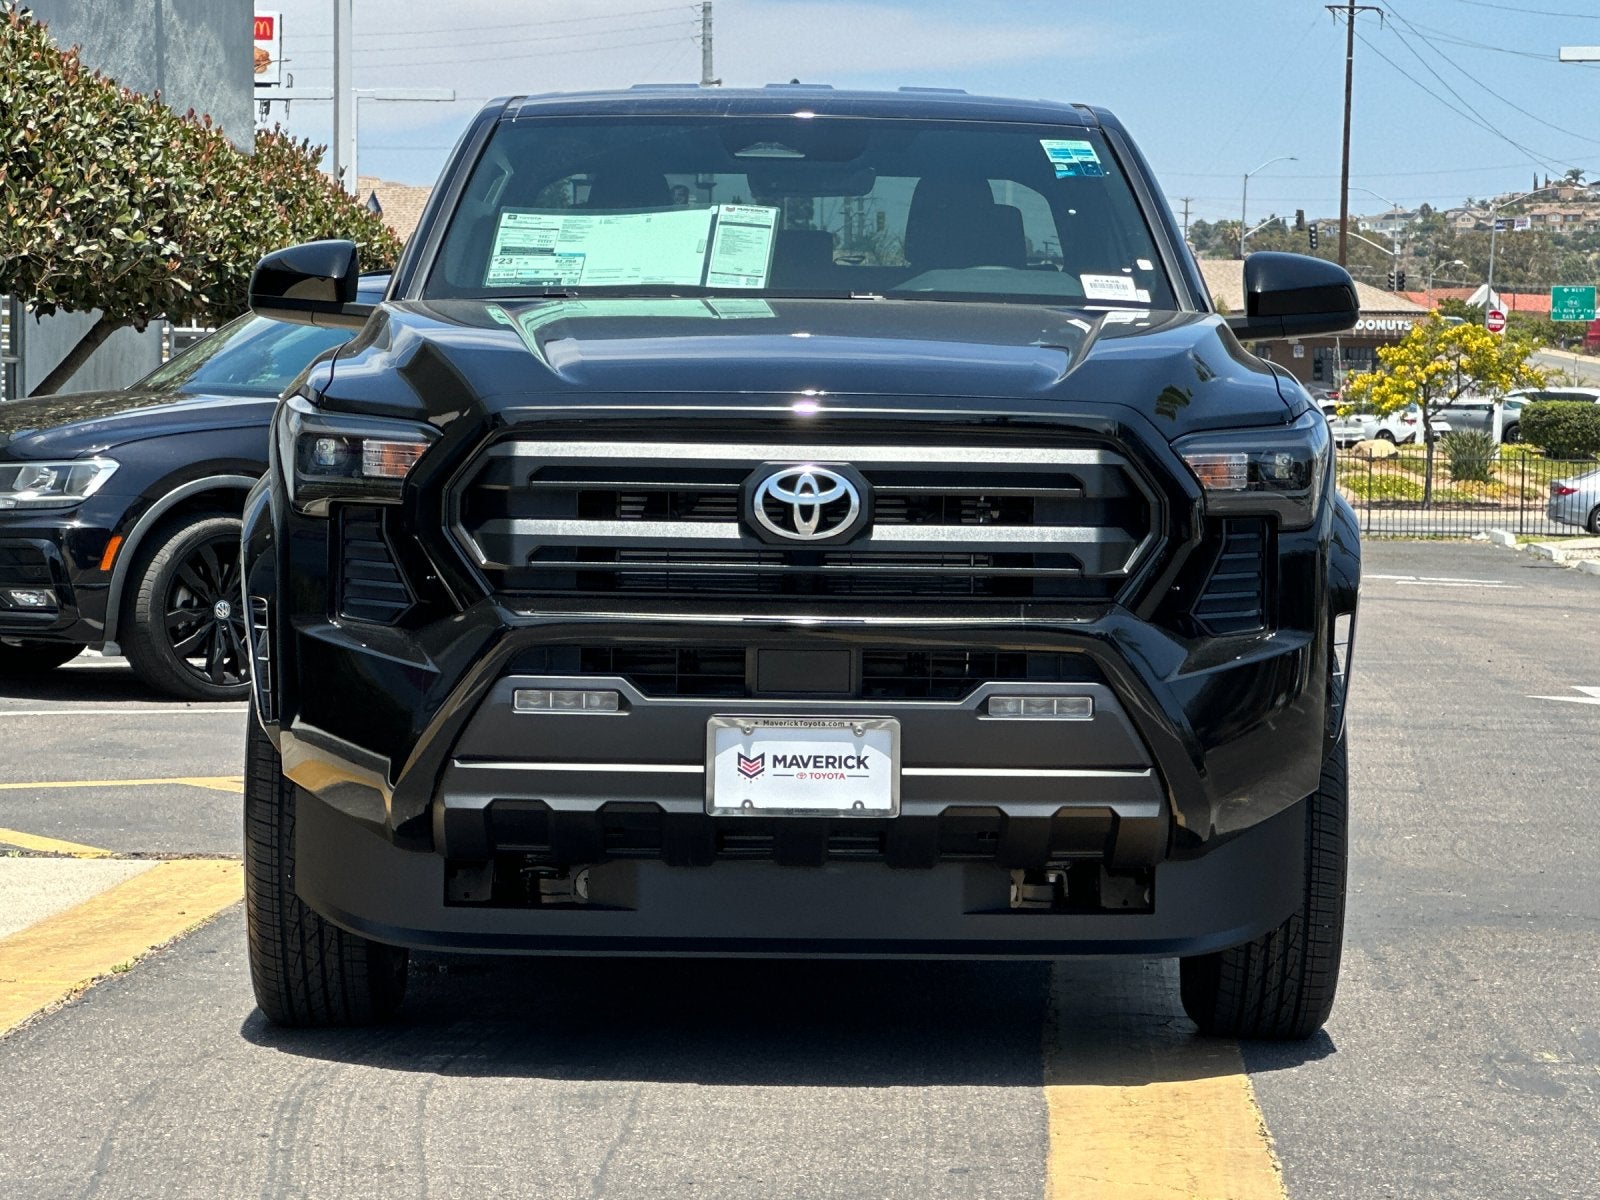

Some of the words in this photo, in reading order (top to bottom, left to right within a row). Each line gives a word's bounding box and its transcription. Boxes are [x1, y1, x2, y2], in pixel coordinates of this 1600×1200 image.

[1355, 319, 1412, 331] DONUTS
[763, 720, 845, 728] MaverickToyota.com
[772, 754, 870, 770] MAVERICK
[809, 772, 846, 780] TOYOTA
